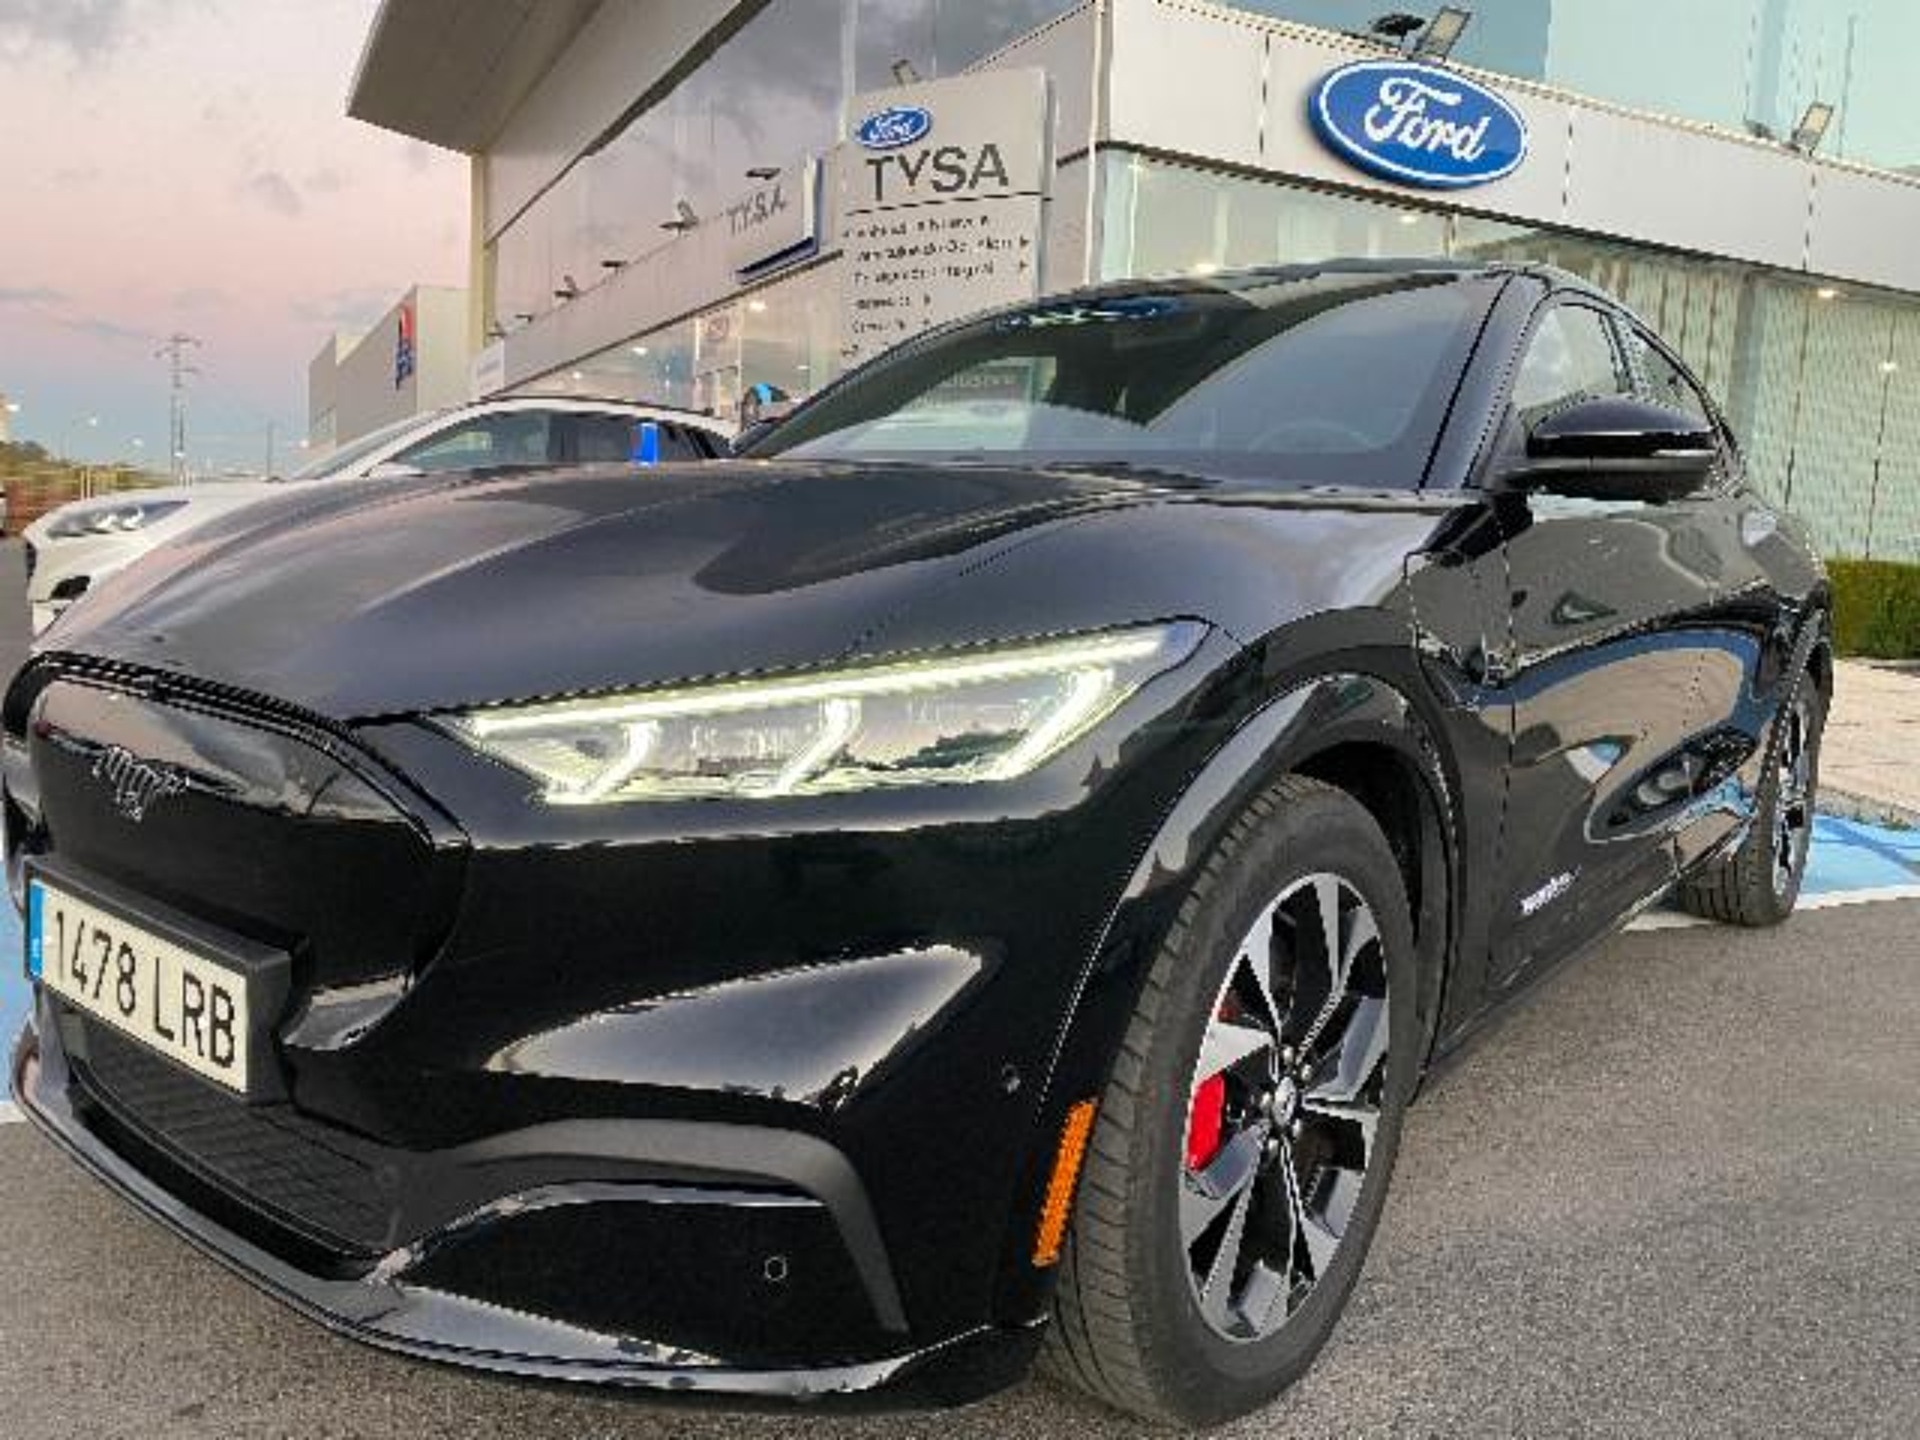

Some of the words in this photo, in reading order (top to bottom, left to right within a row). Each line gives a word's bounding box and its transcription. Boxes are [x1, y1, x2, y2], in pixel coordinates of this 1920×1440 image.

[868, 113, 914, 141] Ford
[1364, 77, 1491, 162] Ford
[866, 143, 1008, 201] TYSA
[57, 911, 136, 1017] 1478
[155, 957, 235, 1068] LRB
